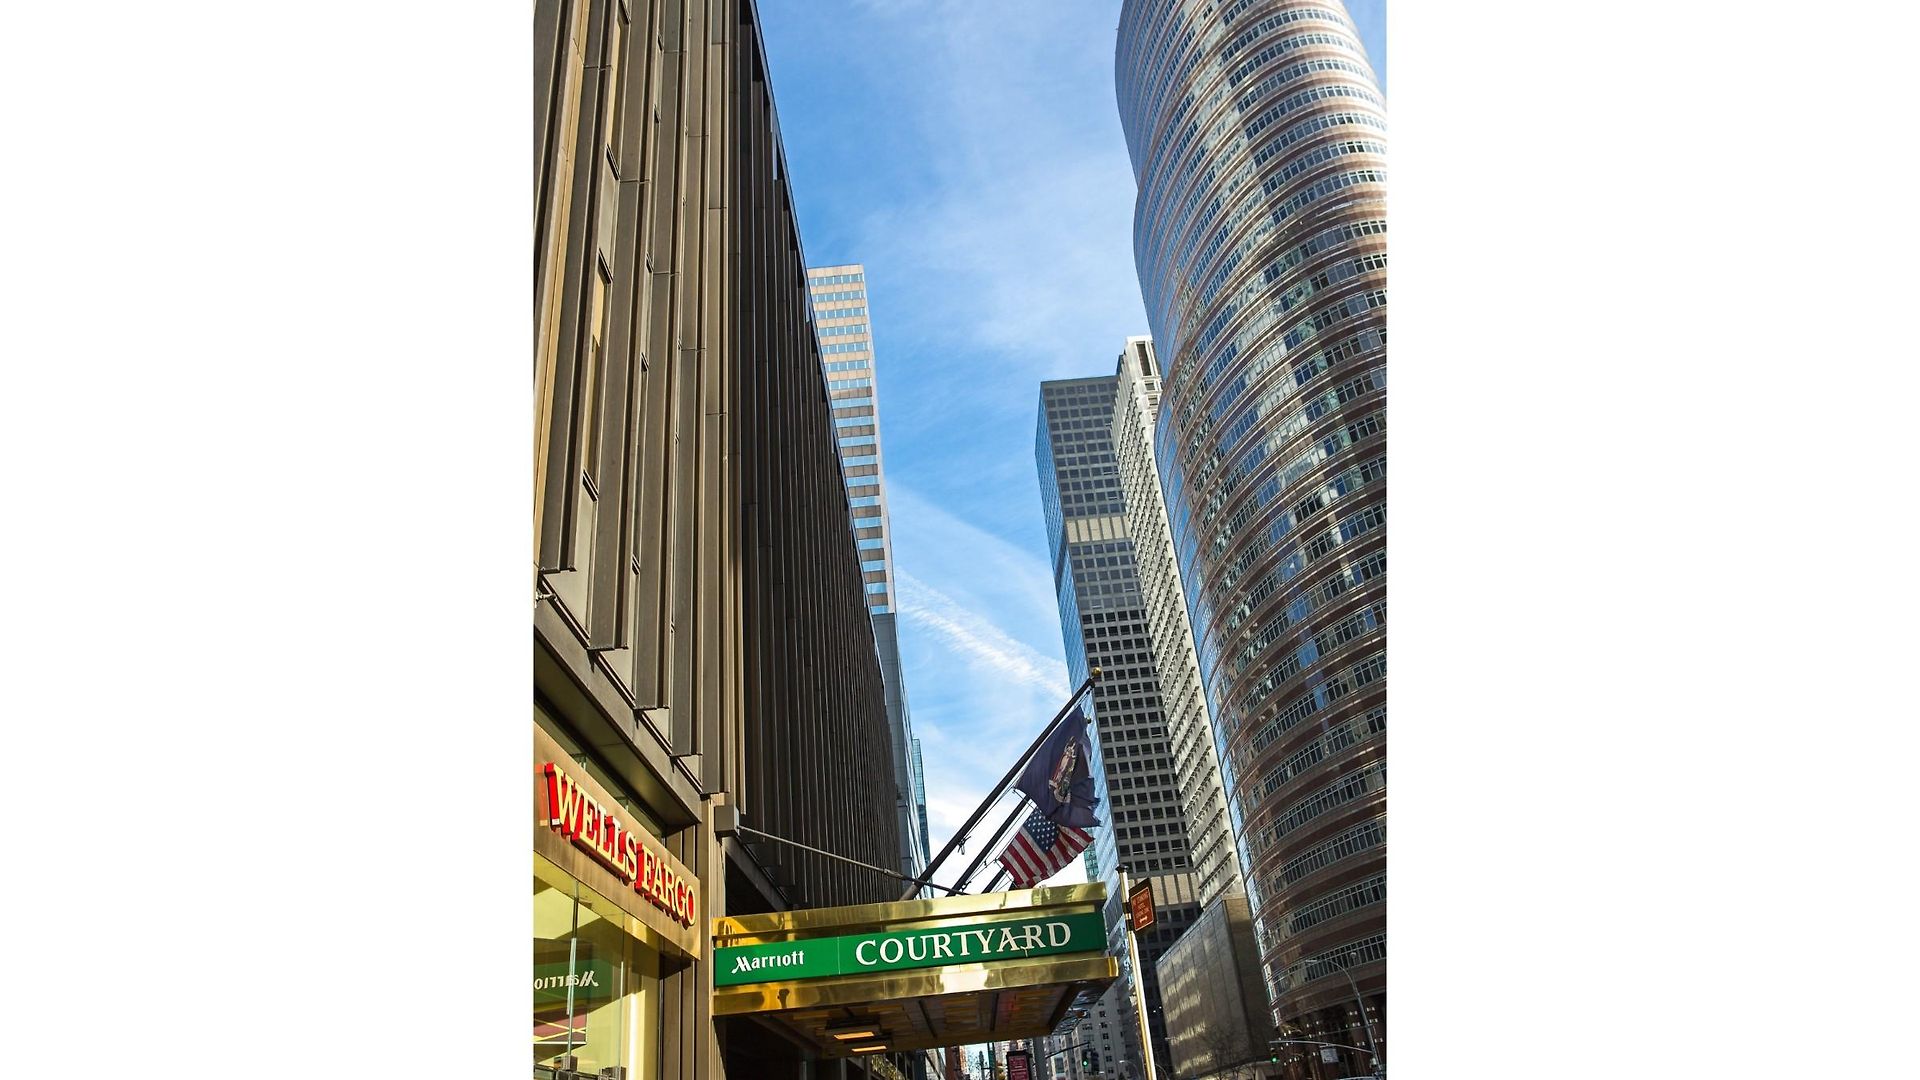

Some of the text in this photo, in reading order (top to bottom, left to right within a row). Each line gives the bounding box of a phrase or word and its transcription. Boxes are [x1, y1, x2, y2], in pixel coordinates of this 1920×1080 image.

[546, 763, 696, 926] WELLS FARGO
[731, 950, 804, 974] Marriott
[855, 922, 1071, 966] COURTYARD
